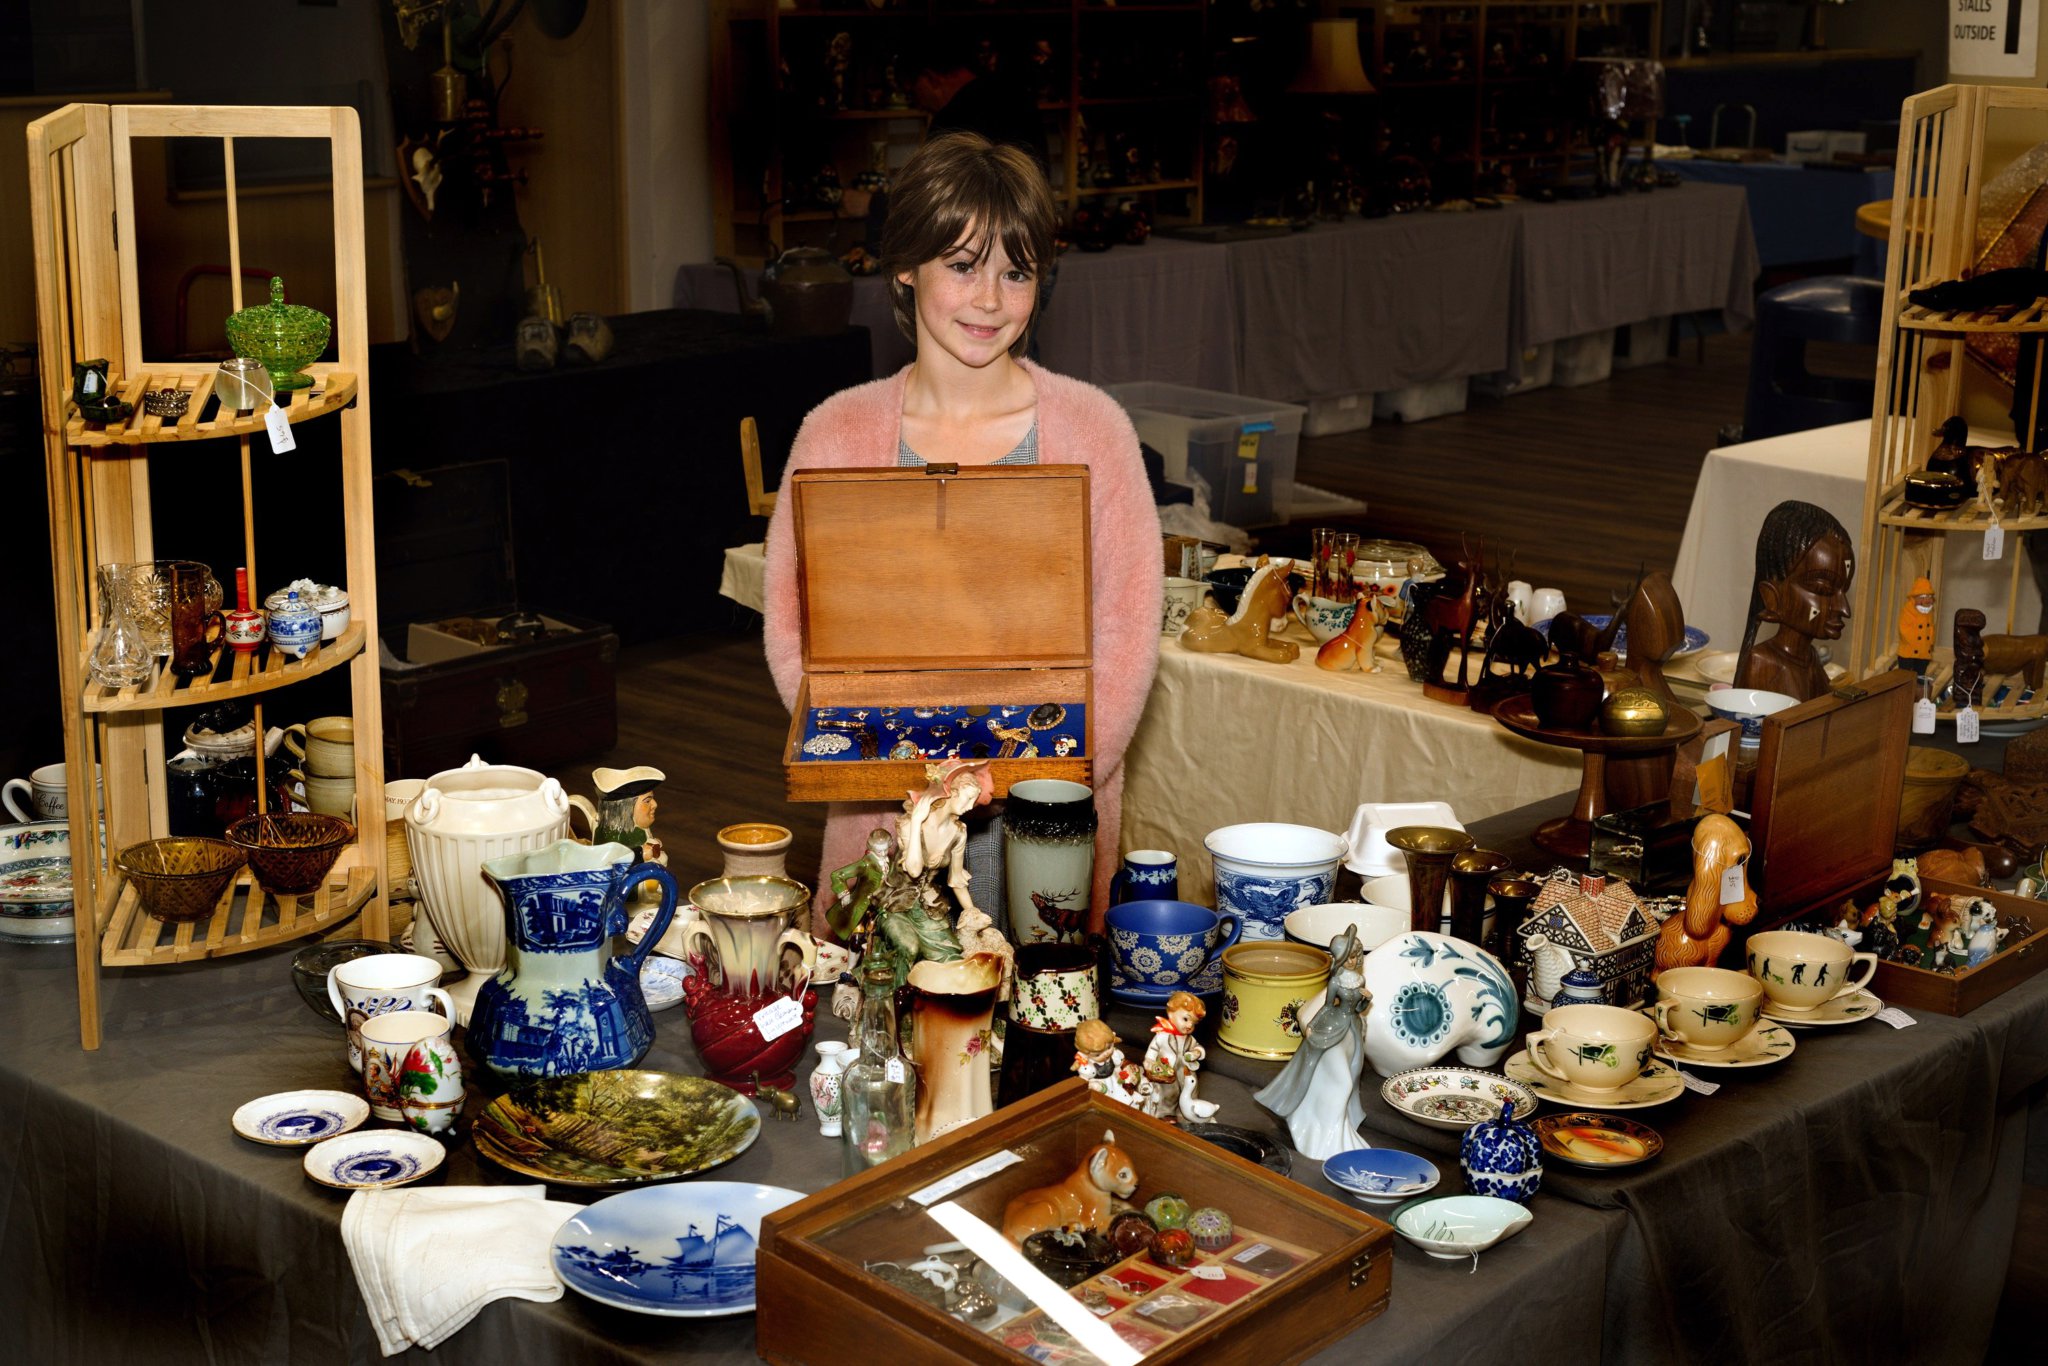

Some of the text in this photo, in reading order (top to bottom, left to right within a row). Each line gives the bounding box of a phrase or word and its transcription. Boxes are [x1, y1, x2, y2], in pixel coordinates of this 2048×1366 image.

[1957, 0, 1992, 12] STALLS
[1954, 24, 1997, 41] OUTSIDE
[38, 793, 65, 815] Coffee
